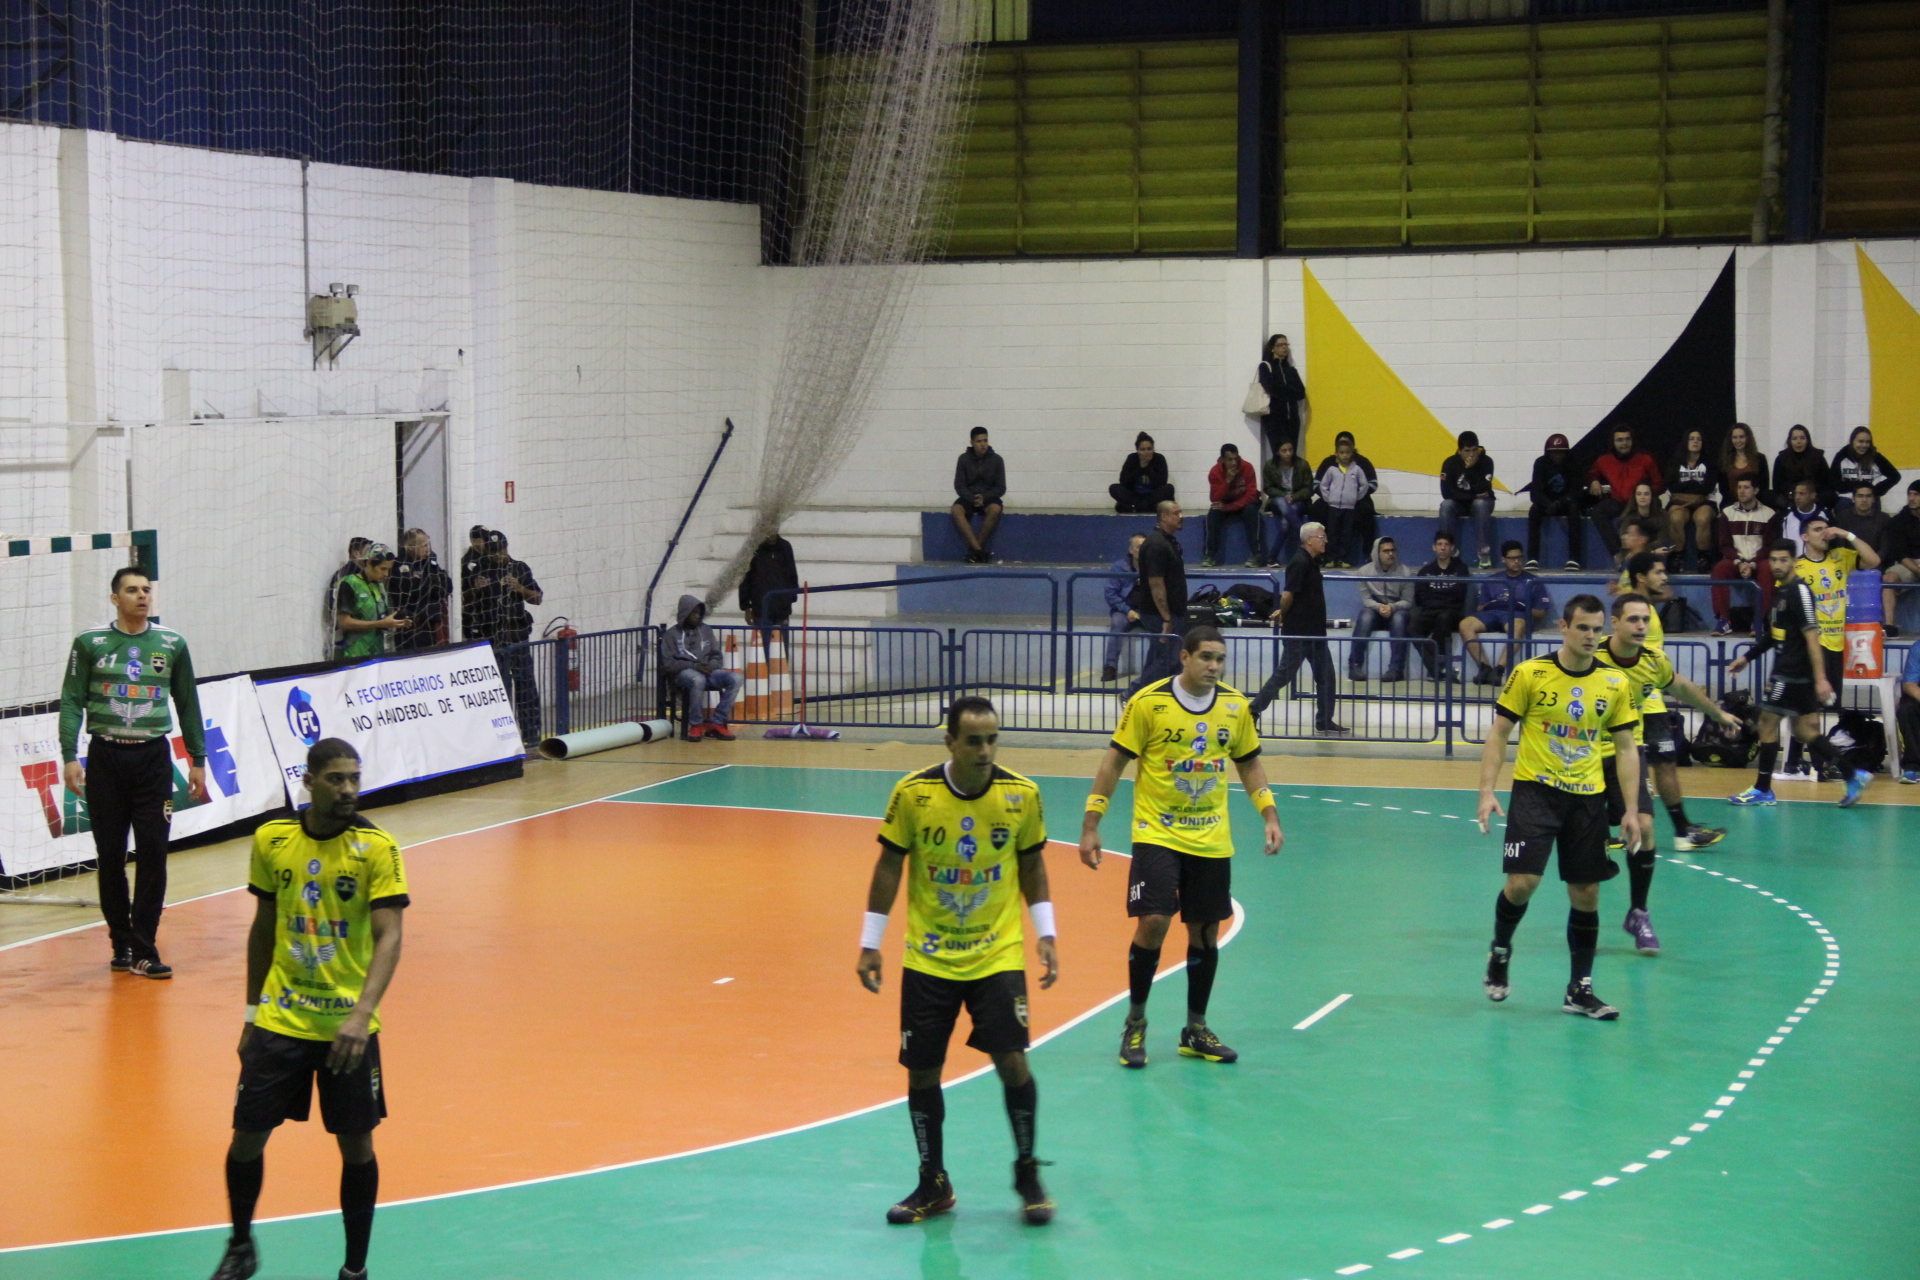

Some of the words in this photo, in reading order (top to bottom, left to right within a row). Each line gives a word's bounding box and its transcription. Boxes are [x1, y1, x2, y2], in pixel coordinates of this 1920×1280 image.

[1851, 635, 1868, 652] G
[344, 692, 355, 708] A
[450, 665, 500, 688] ACREDITA
[1536, 691, 1558, 707] 23
[351, 715, 373, 733] NO
[377, 702, 433, 727] HANDEBOL
[438, 698, 454, 714] DE
[459, 684, 507, 710] TAUBATÉ
[491, 716, 515, 729] MOTTA
[1162, 728, 1186, 743] 25
[1554, 780, 1595, 792] UNITAU
[1179, 815, 1222, 826] UNITAU
[921, 826, 946, 846] 10
[275, 868, 293, 890] 19
